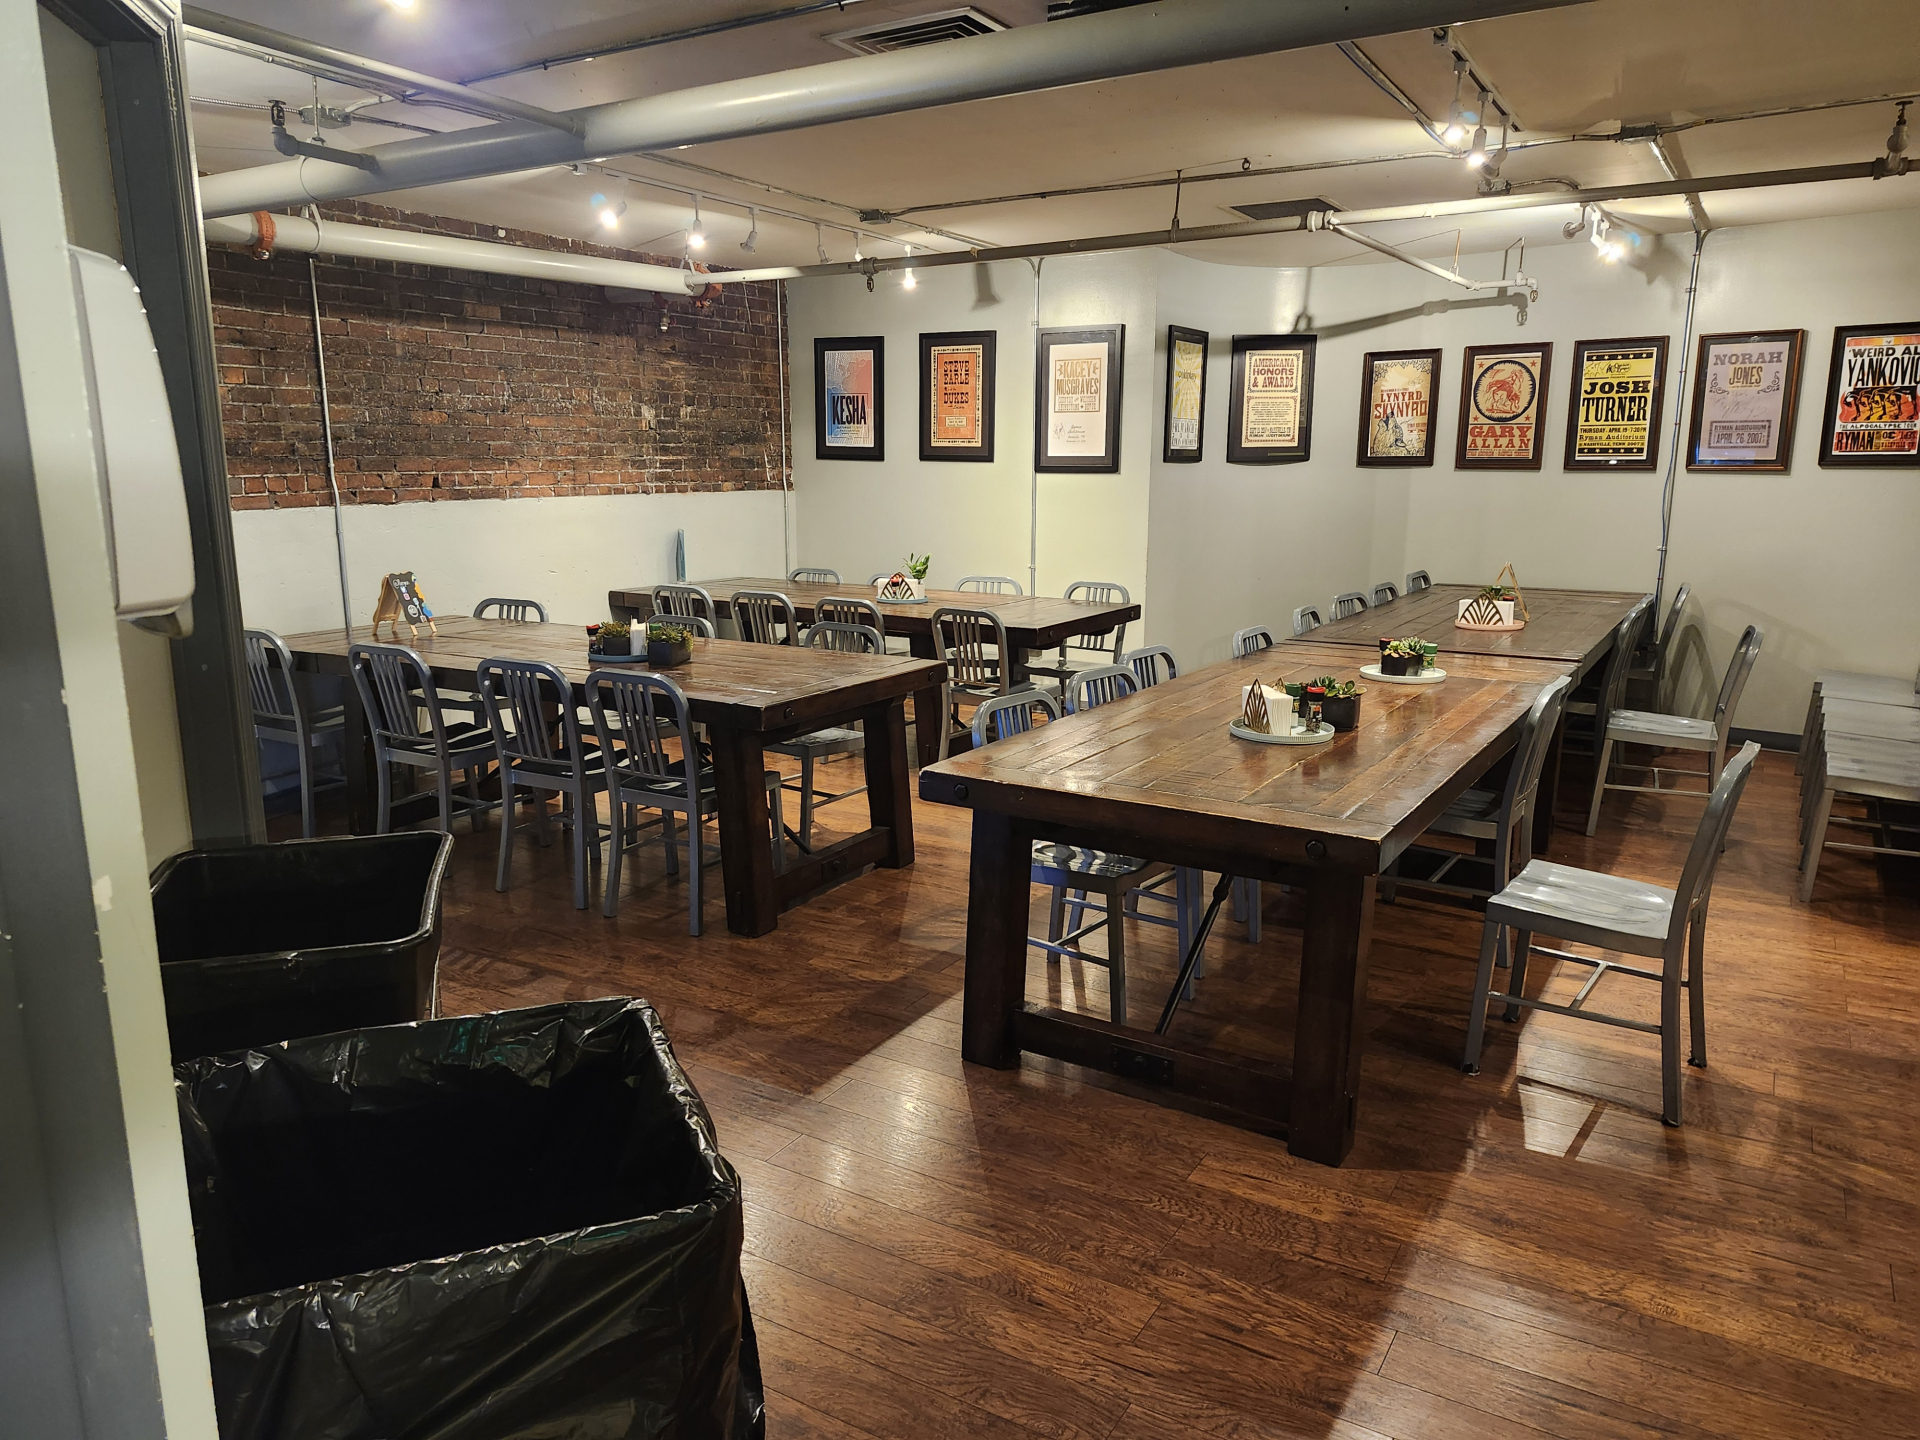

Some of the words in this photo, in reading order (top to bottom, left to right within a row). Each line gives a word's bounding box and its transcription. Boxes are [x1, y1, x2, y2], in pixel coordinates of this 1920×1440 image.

[1901, 345, 1920, 356] AL
[1253, 358, 1295, 368] AMERICANA
[1713, 351, 1784, 366] NORAH
[943, 361, 970, 373] STEVE
[1063, 360, 1093, 378] KACEY
[1252, 368, 1295, 376] HONORS
[943, 373, 970, 385] EARLE
[1729, 366, 1763, 385] JONES
[1056, 378, 1099, 396] MUSGRAVES
[1252, 376, 1259, 388] &
[1262, 376, 1294, 388] AWARDS
[1584, 380, 1651, 395] JOSH
[943, 392, 970, 404] DUKES
[1380, 391, 1422, 402] LYNYRD
[832, 395, 867, 425] KESHA
[1374, 400, 1428, 419] SKYNYRD
[1582, 395, 1648, 423] TURNER
[1469, 425, 1533, 438] GARY
[1467, 438, 1531, 449] ALLAN
[1716, 432, 1734, 444] APRIL
[1746, 432, 1763, 444] 2007
[1835, 431, 1875, 451] RYMAN
